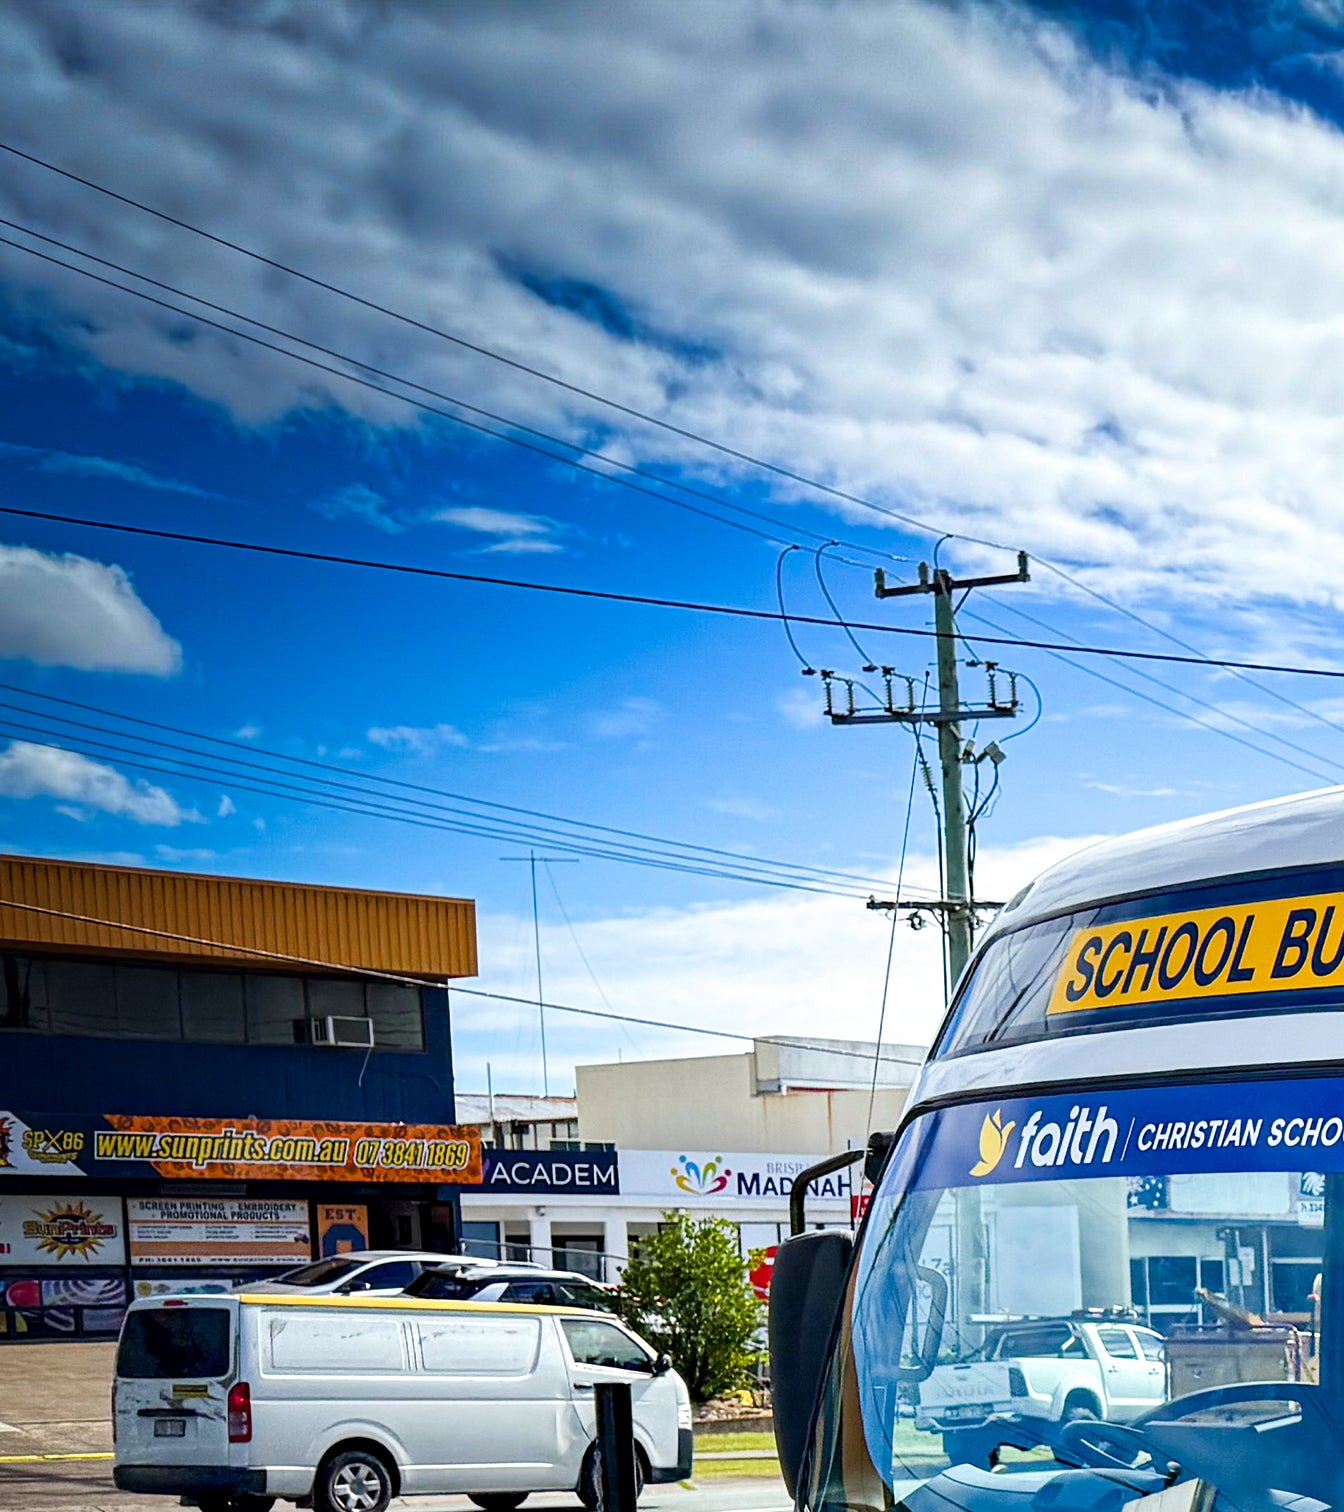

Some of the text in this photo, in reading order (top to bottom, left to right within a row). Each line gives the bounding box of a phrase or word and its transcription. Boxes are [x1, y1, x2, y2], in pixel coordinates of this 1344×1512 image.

[1066, 914, 1255, 1001] SCHOOL
[97, 1131, 347, 1165] www.sunprints.com.au
[356, 1139, 381, 1165] 07
[382, 1141, 423, 1166] 3841
[427, 1140, 469, 1167] 1869
[1014, 1105, 1119, 1169] faith
[1136, 1117, 1261, 1152] CHRISTIAN
[737, 1173, 851, 1196] MADNAH
[160, 1211, 280, 1220] PROMOTIONAL PRODUCTS
[180, 1202, 225, 1211] PRINTING
